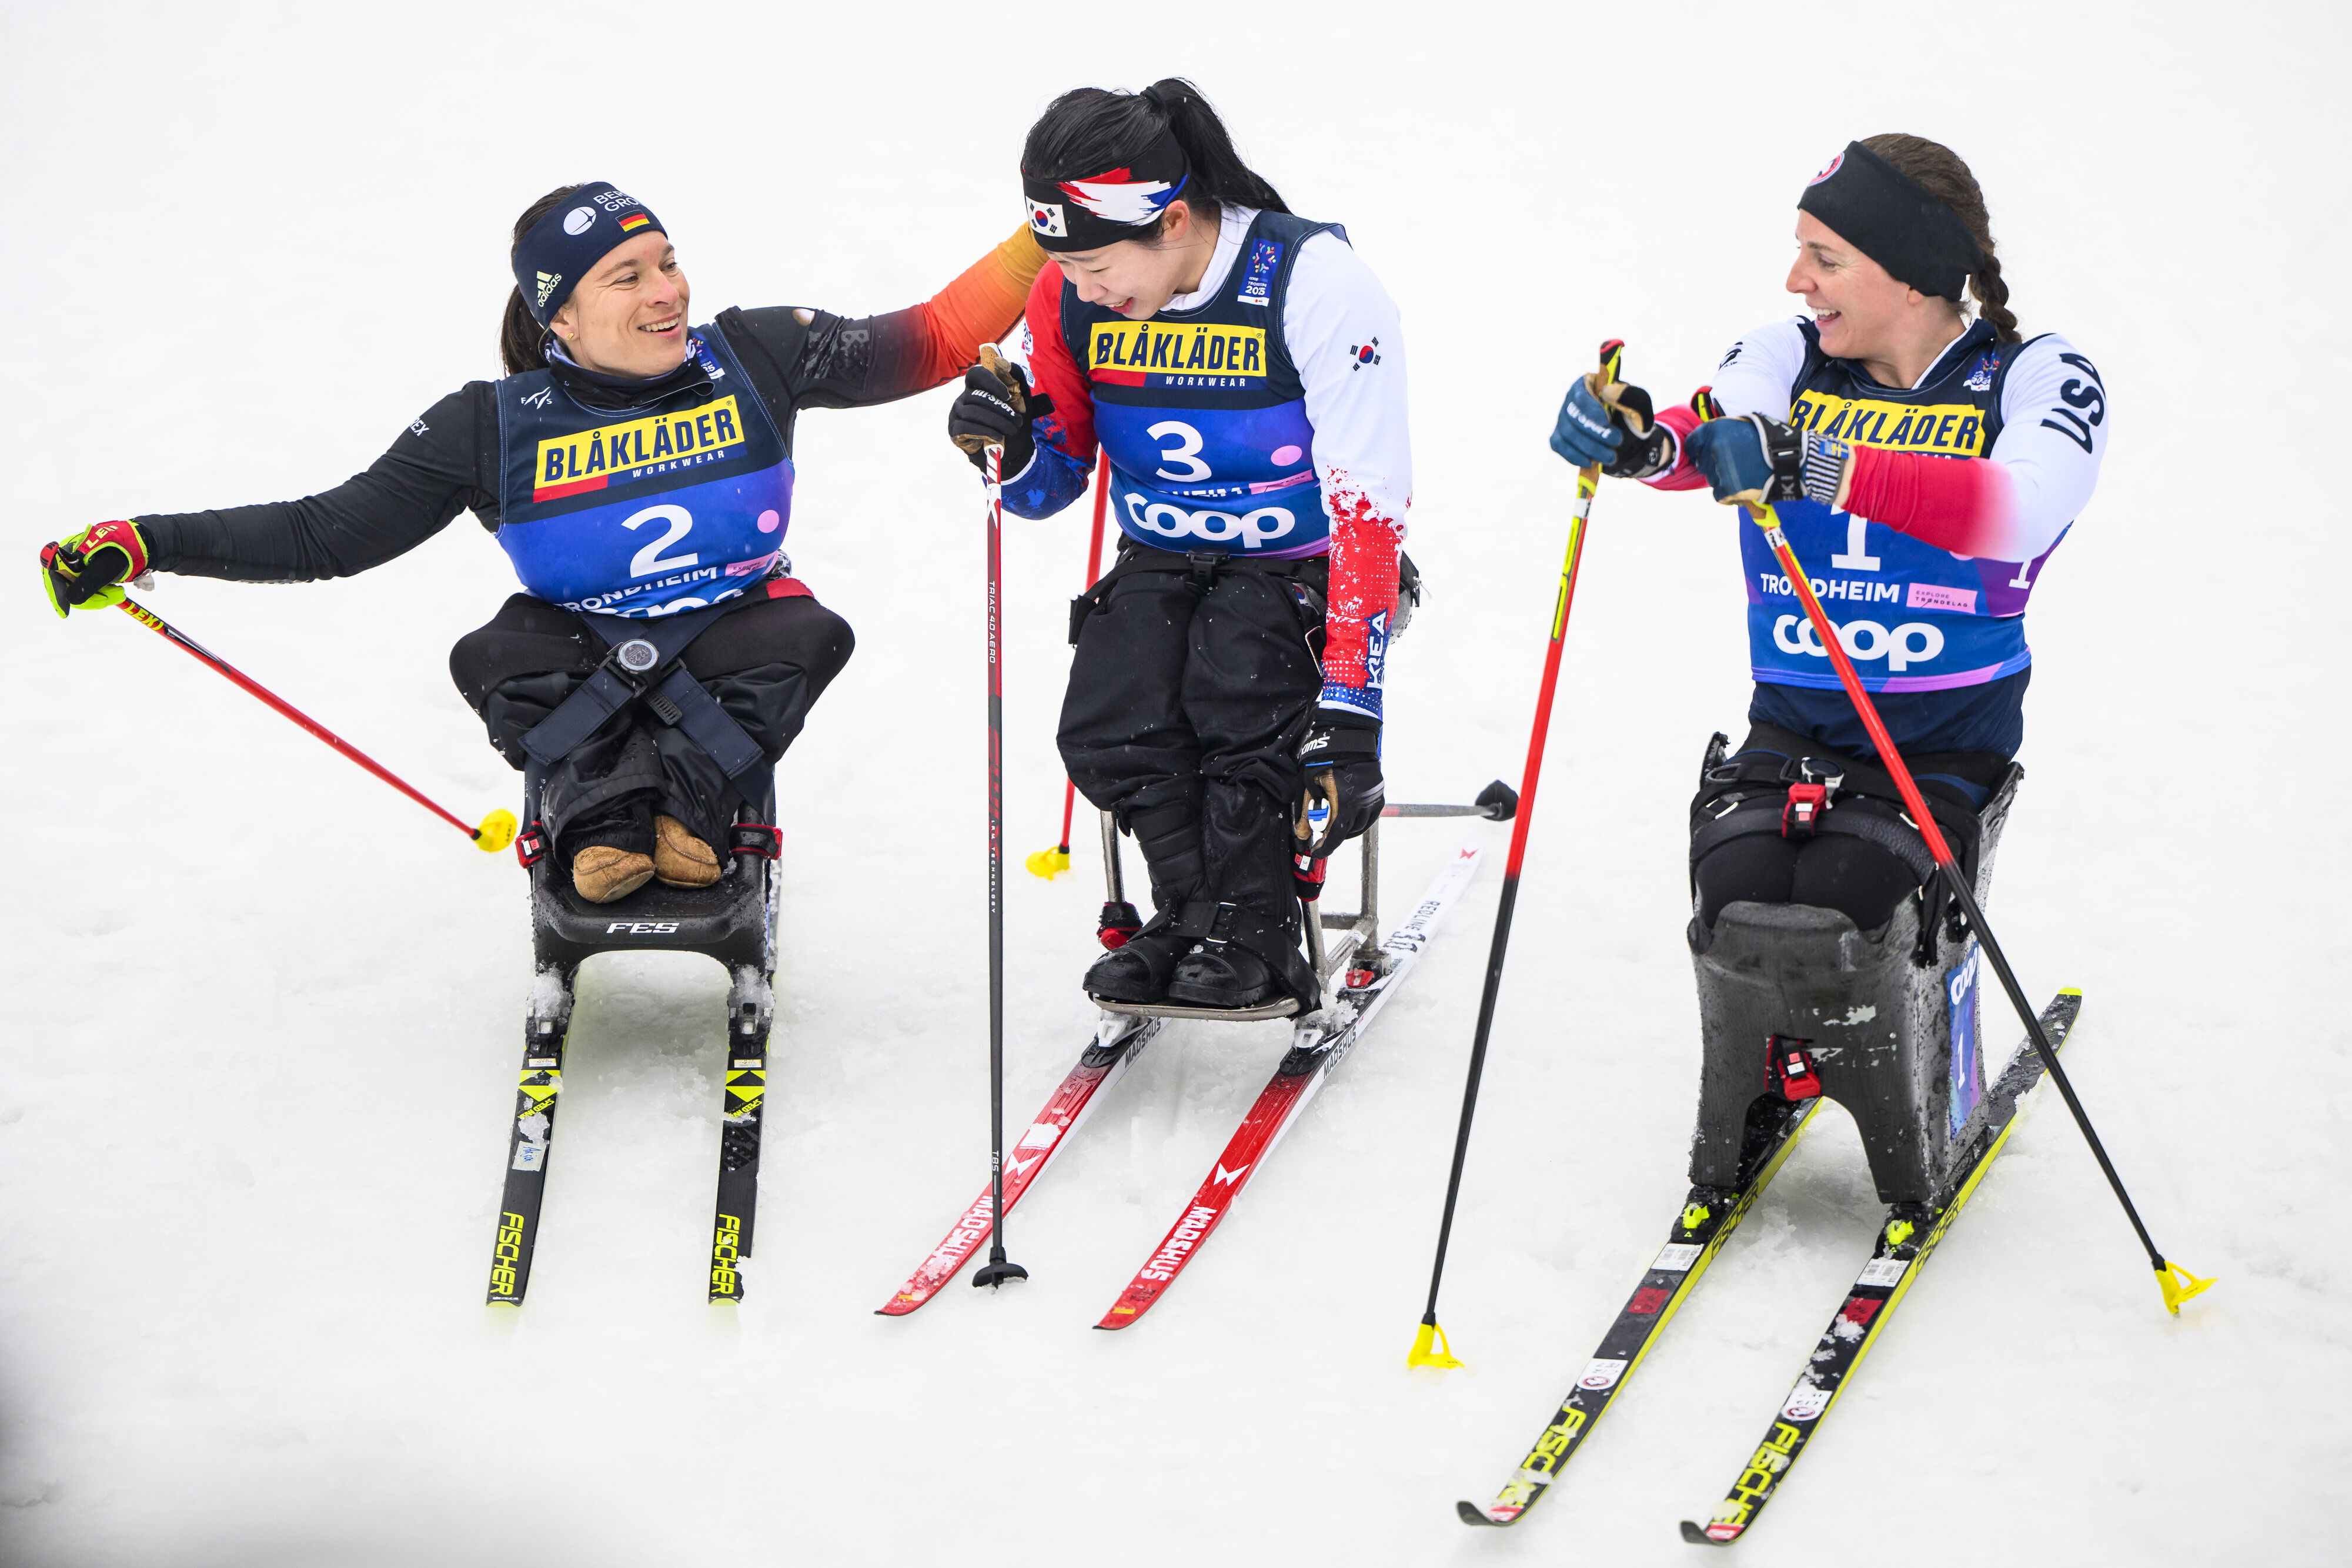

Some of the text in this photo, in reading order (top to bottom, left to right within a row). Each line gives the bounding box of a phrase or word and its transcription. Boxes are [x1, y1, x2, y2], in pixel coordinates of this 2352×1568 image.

[537, 273, 562, 307] adidas
[1094, 323, 1259, 371] BLÅKLÄDER
[1165, 376, 1245, 387] WORKWEAR
[2040, 353, 2106, 454] USA
[544, 409, 737, 482] BLÅKLÄDER
[1147, 420, 1212, 483] 3
[1789, 399, 1980, 450] BLÅKLÄDER
[632, 450, 725, 478] WORKWEAR
[621, 504, 699, 579] 2
[1124, 493, 1295, 548] coop
[1760, 573, 1900, 603] TRODHEIM
[1915, 590, 1950, 599] EXPLORE
[1773, 614, 1945, 671] coop
[606, 922, 680, 934] FES
[1125, 1017, 1161, 1069] MADSHUS
[1323, 1025, 1357, 1080] MADSHUS
[1958, 1032, 1966, 1089] 1
[1140, 1206, 1218, 1281] MADSHUS
[1711, 1181, 1759, 1261] FISCHER
[1916, 1196, 1959, 1275] FISCHER
[490, 1211, 524, 1295] FISCHER
[711, 1213, 740, 1294] FISCHER
